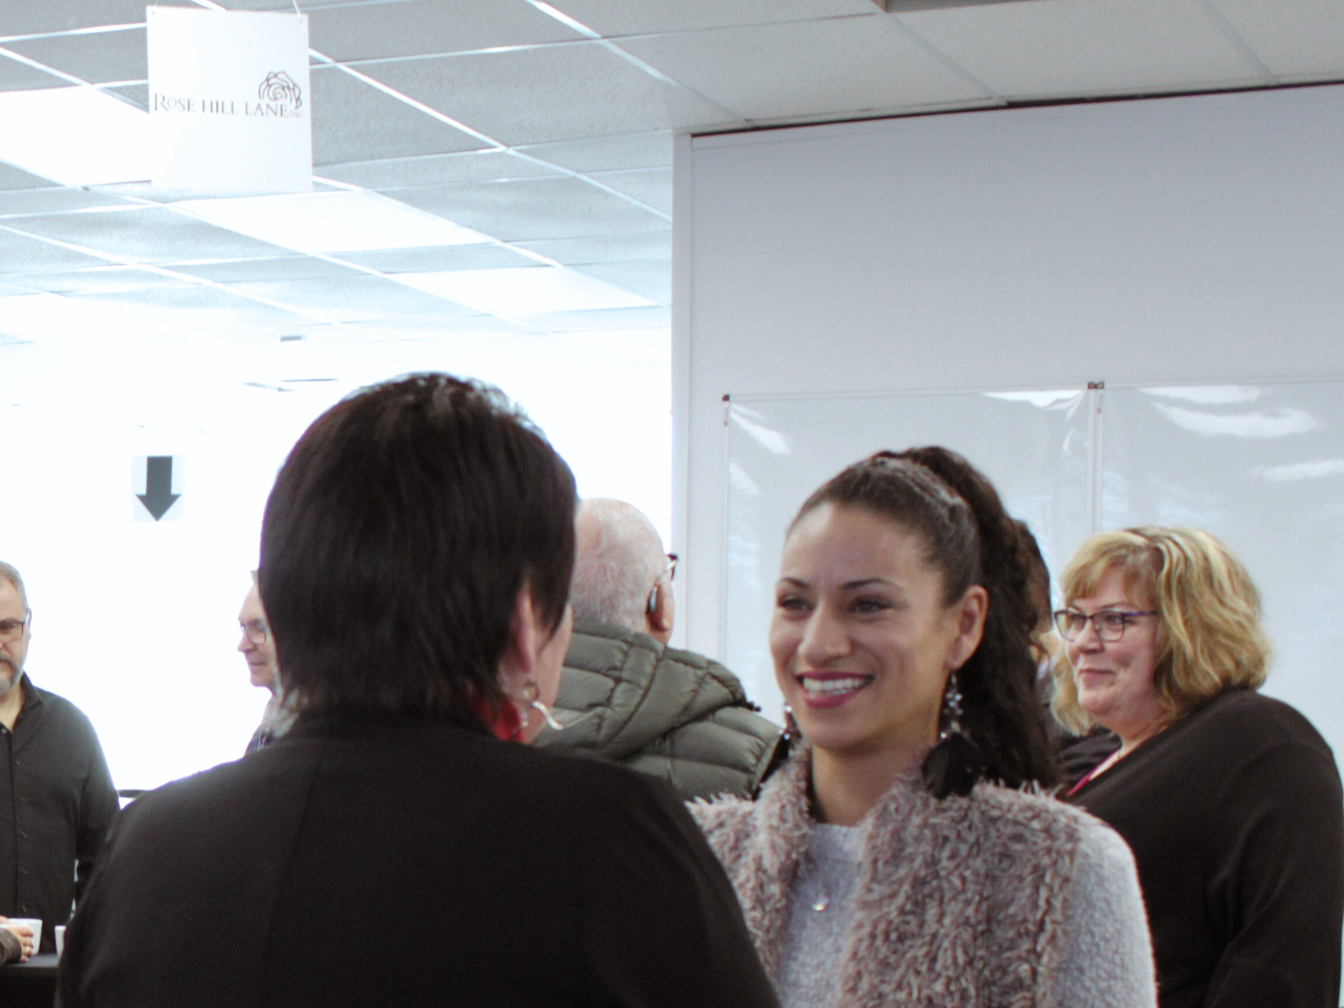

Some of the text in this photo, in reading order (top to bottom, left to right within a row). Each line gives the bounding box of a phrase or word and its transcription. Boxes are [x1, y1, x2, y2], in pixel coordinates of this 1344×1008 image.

[154, 92, 195, 112] ROSE
[202, 99, 239, 114] HILL
[245, 101, 288, 118] LANE
